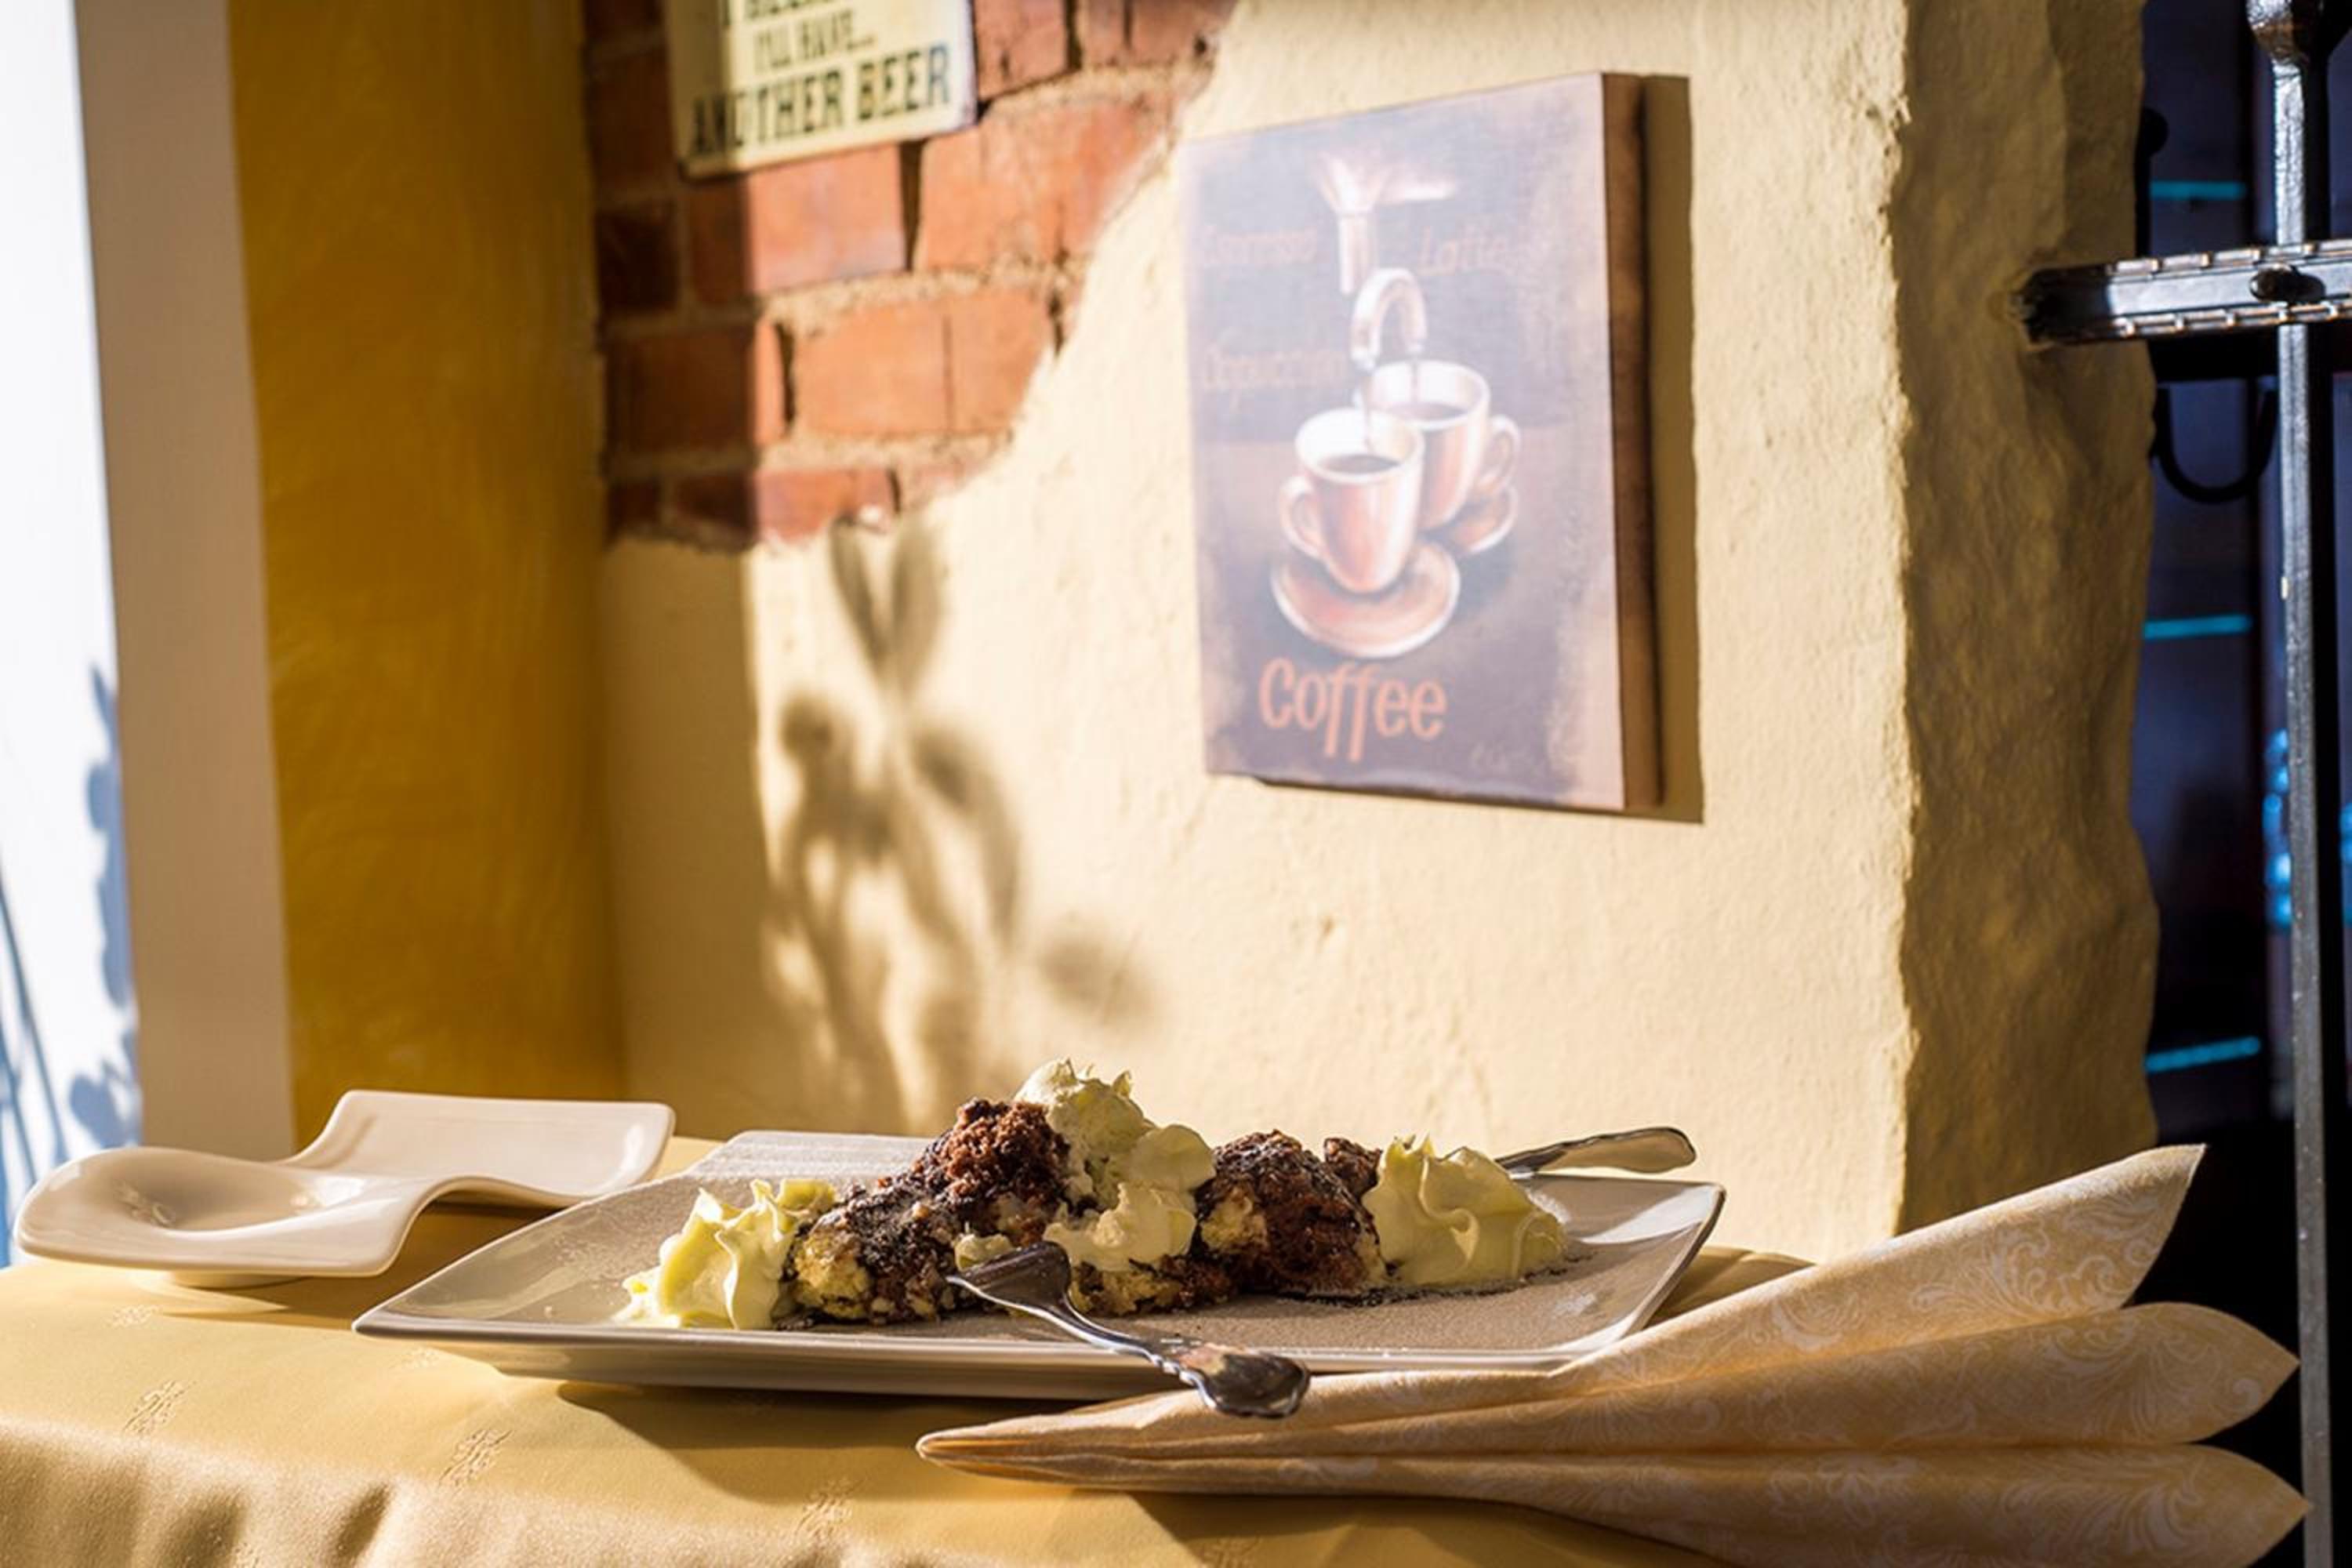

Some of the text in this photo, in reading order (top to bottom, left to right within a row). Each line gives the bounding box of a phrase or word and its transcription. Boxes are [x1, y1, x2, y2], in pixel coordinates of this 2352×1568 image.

[689, 43, 951, 156] ANOTHER BEER
[1258, 657, 1447, 763] Coffee
